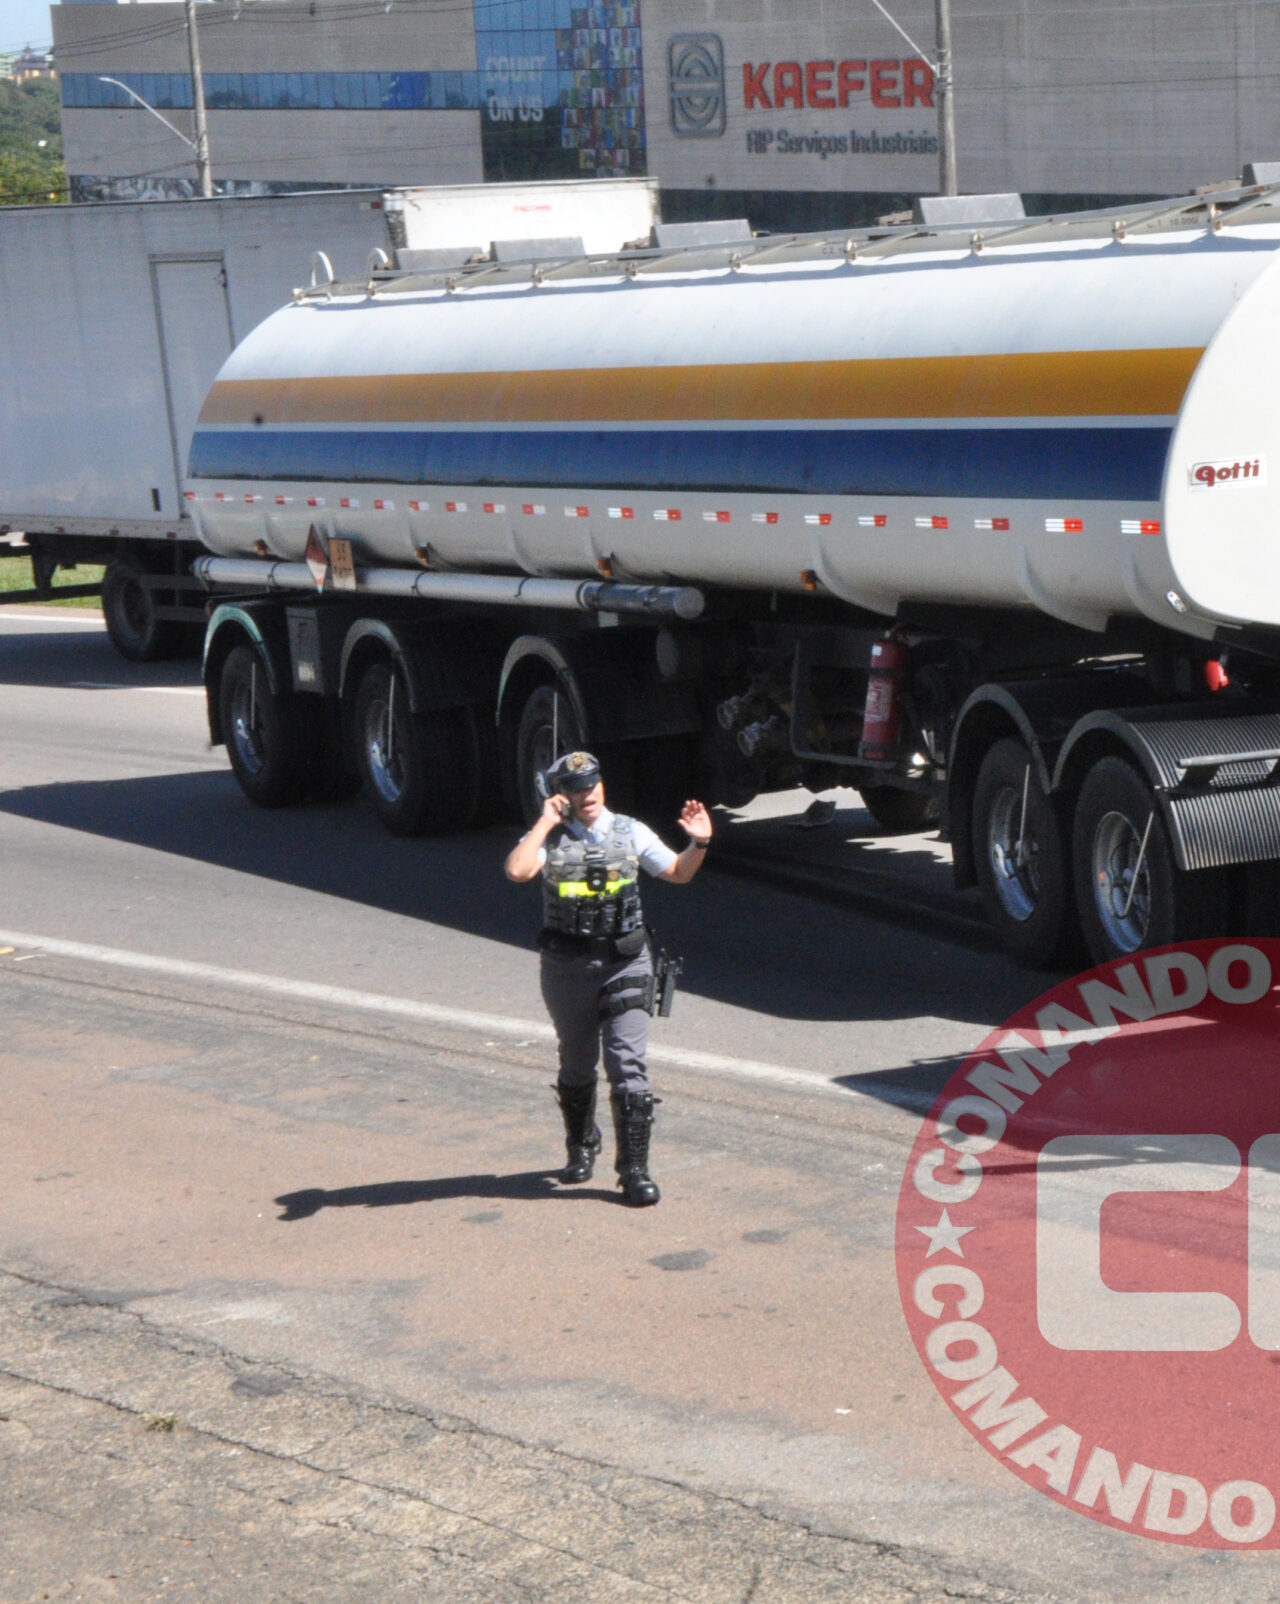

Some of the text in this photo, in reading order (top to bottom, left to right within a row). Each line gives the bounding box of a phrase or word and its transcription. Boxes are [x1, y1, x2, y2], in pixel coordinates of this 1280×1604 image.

[486, 56, 546, 82] COUNT
[742, 59, 935, 109] KAEFER
[488, 96, 545, 122] ON US
[746, 129, 938, 160] RIP Serviços Industriais
